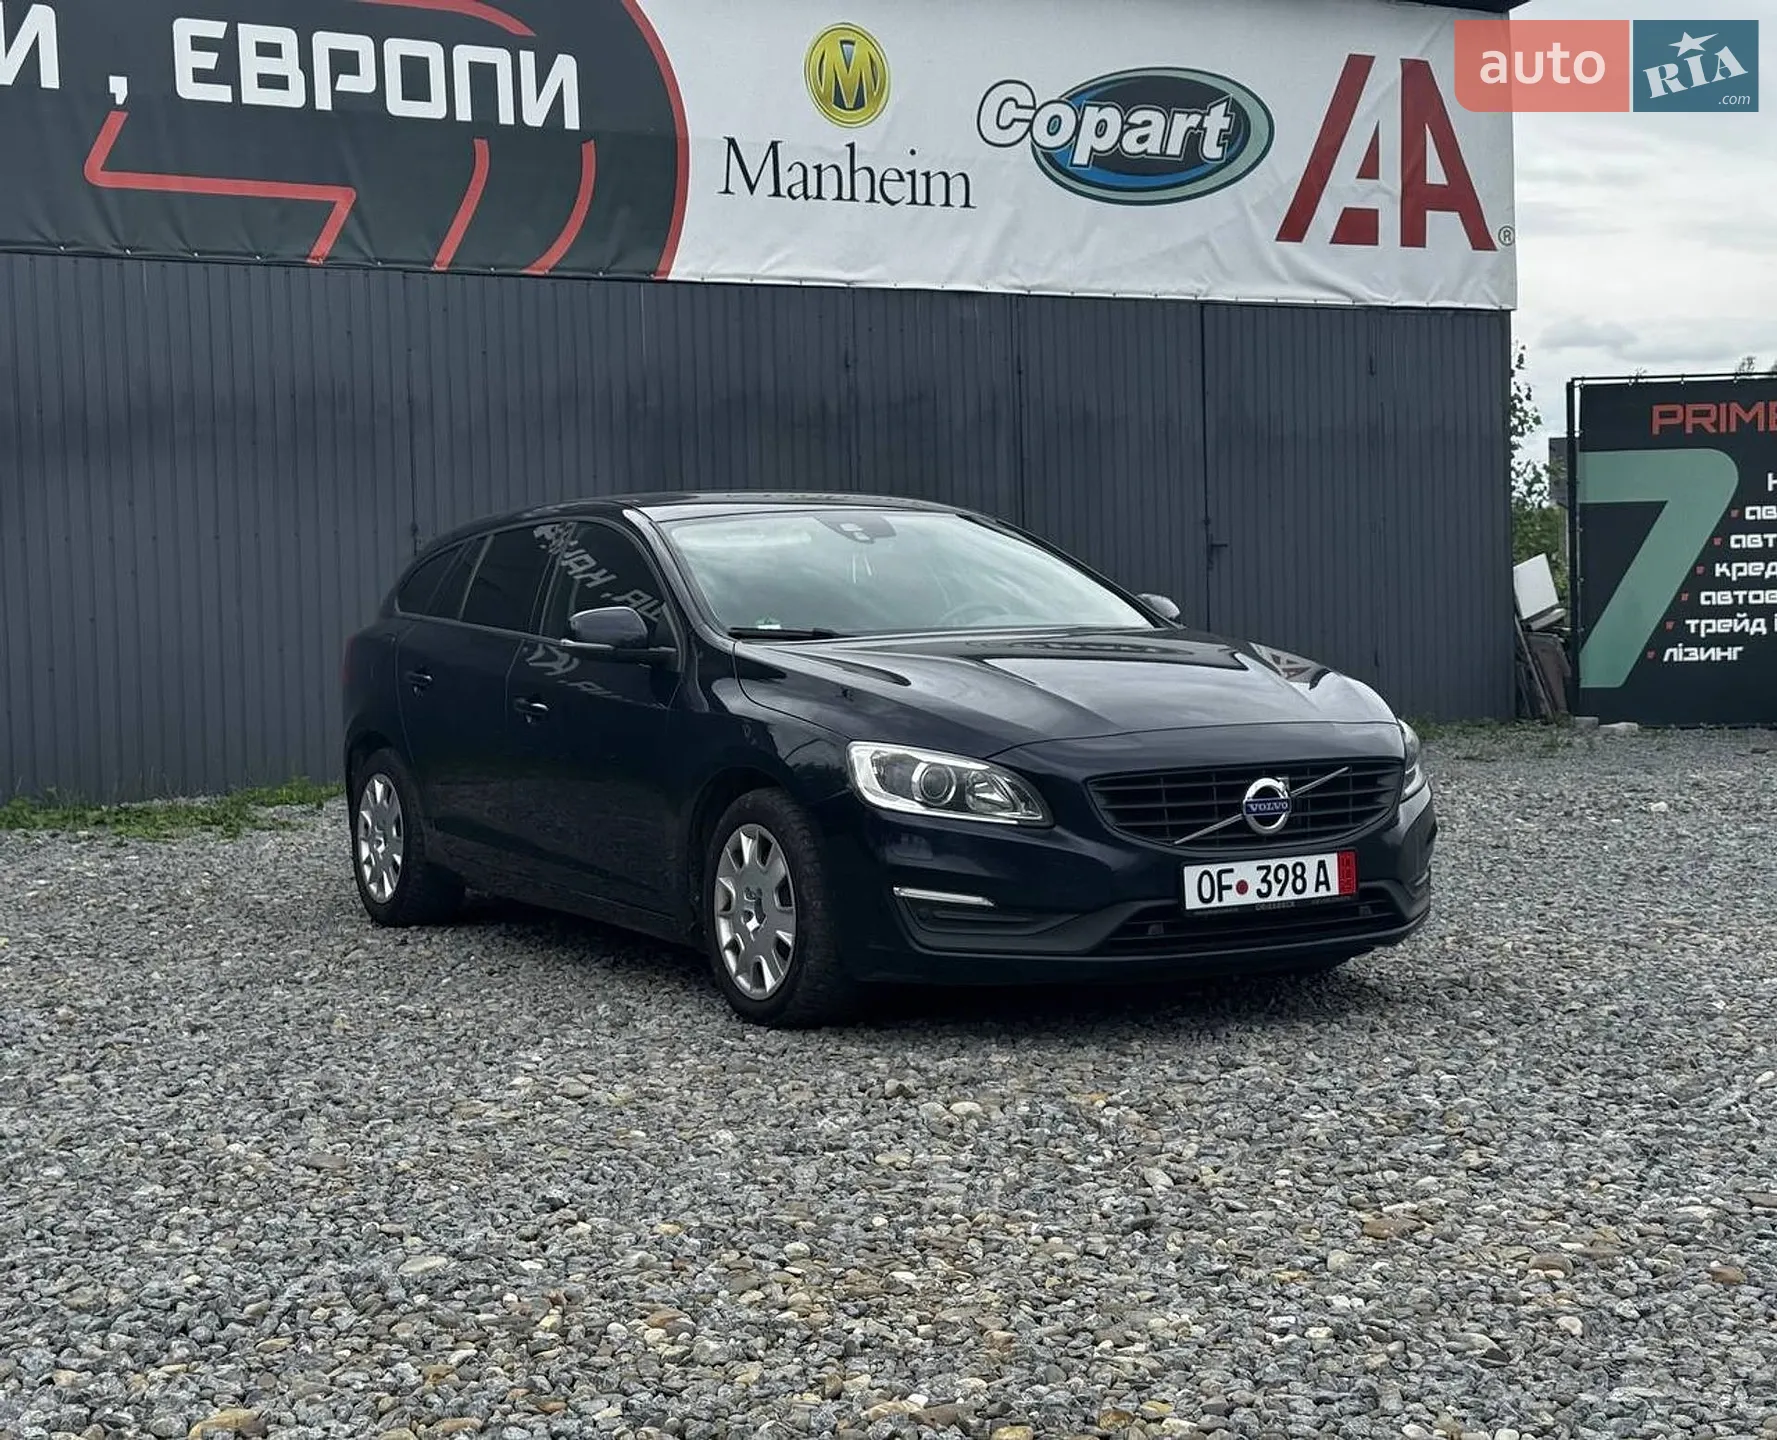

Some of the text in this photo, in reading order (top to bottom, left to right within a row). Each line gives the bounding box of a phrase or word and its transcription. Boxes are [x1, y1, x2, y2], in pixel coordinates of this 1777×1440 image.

[977, 80, 1234, 168] Copart
[718, 136, 978, 210] Manheim
[1684, 612, 1767, 638] трейд
[1662, 643, 1744, 662] лізинг
[1249, 801, 1289, 812] VOLVO
[1197, 867, 1235, 904] OF
[1256, 861, 1307, 899] 398
[1314, 859, 1331, 893] A
